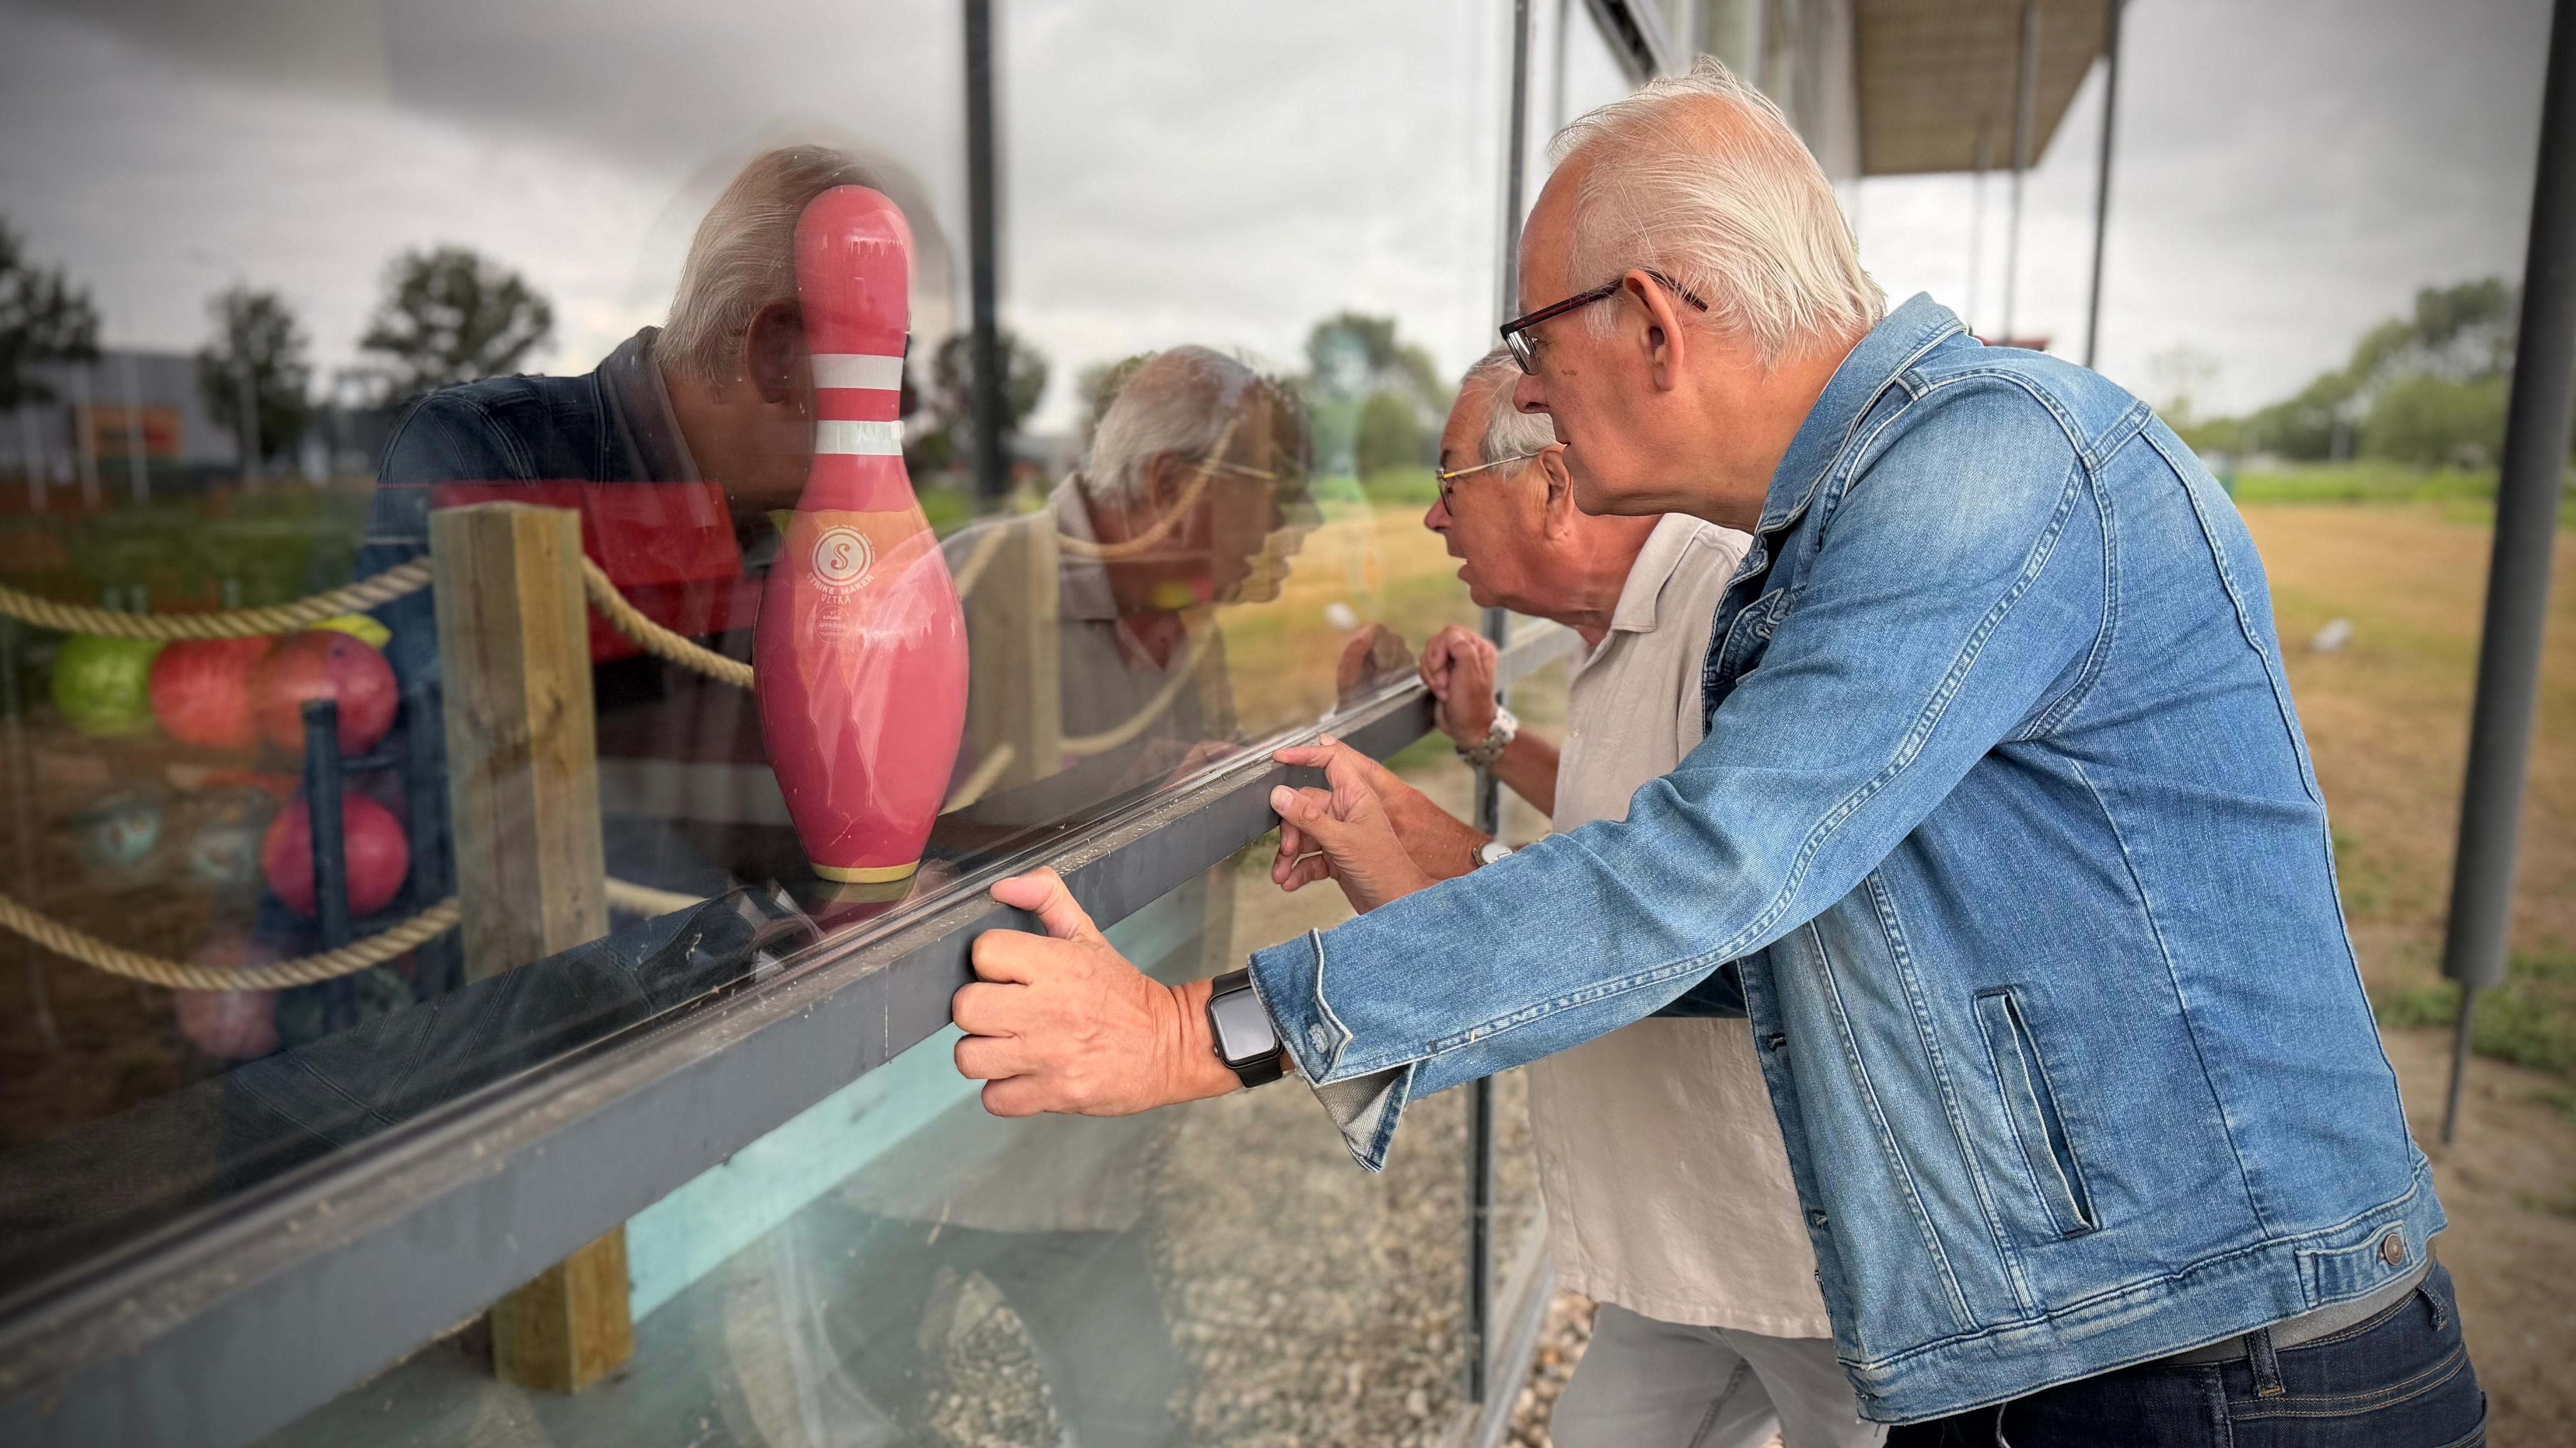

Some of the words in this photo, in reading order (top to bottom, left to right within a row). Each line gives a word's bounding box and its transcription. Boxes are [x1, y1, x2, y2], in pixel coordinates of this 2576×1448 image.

[831, 543, 850, 570] S
[807, 572, 835, 594] STRIKE
[840, 574, 874, 595] MAKER
[821, 594, 852, 604] ULTRA
